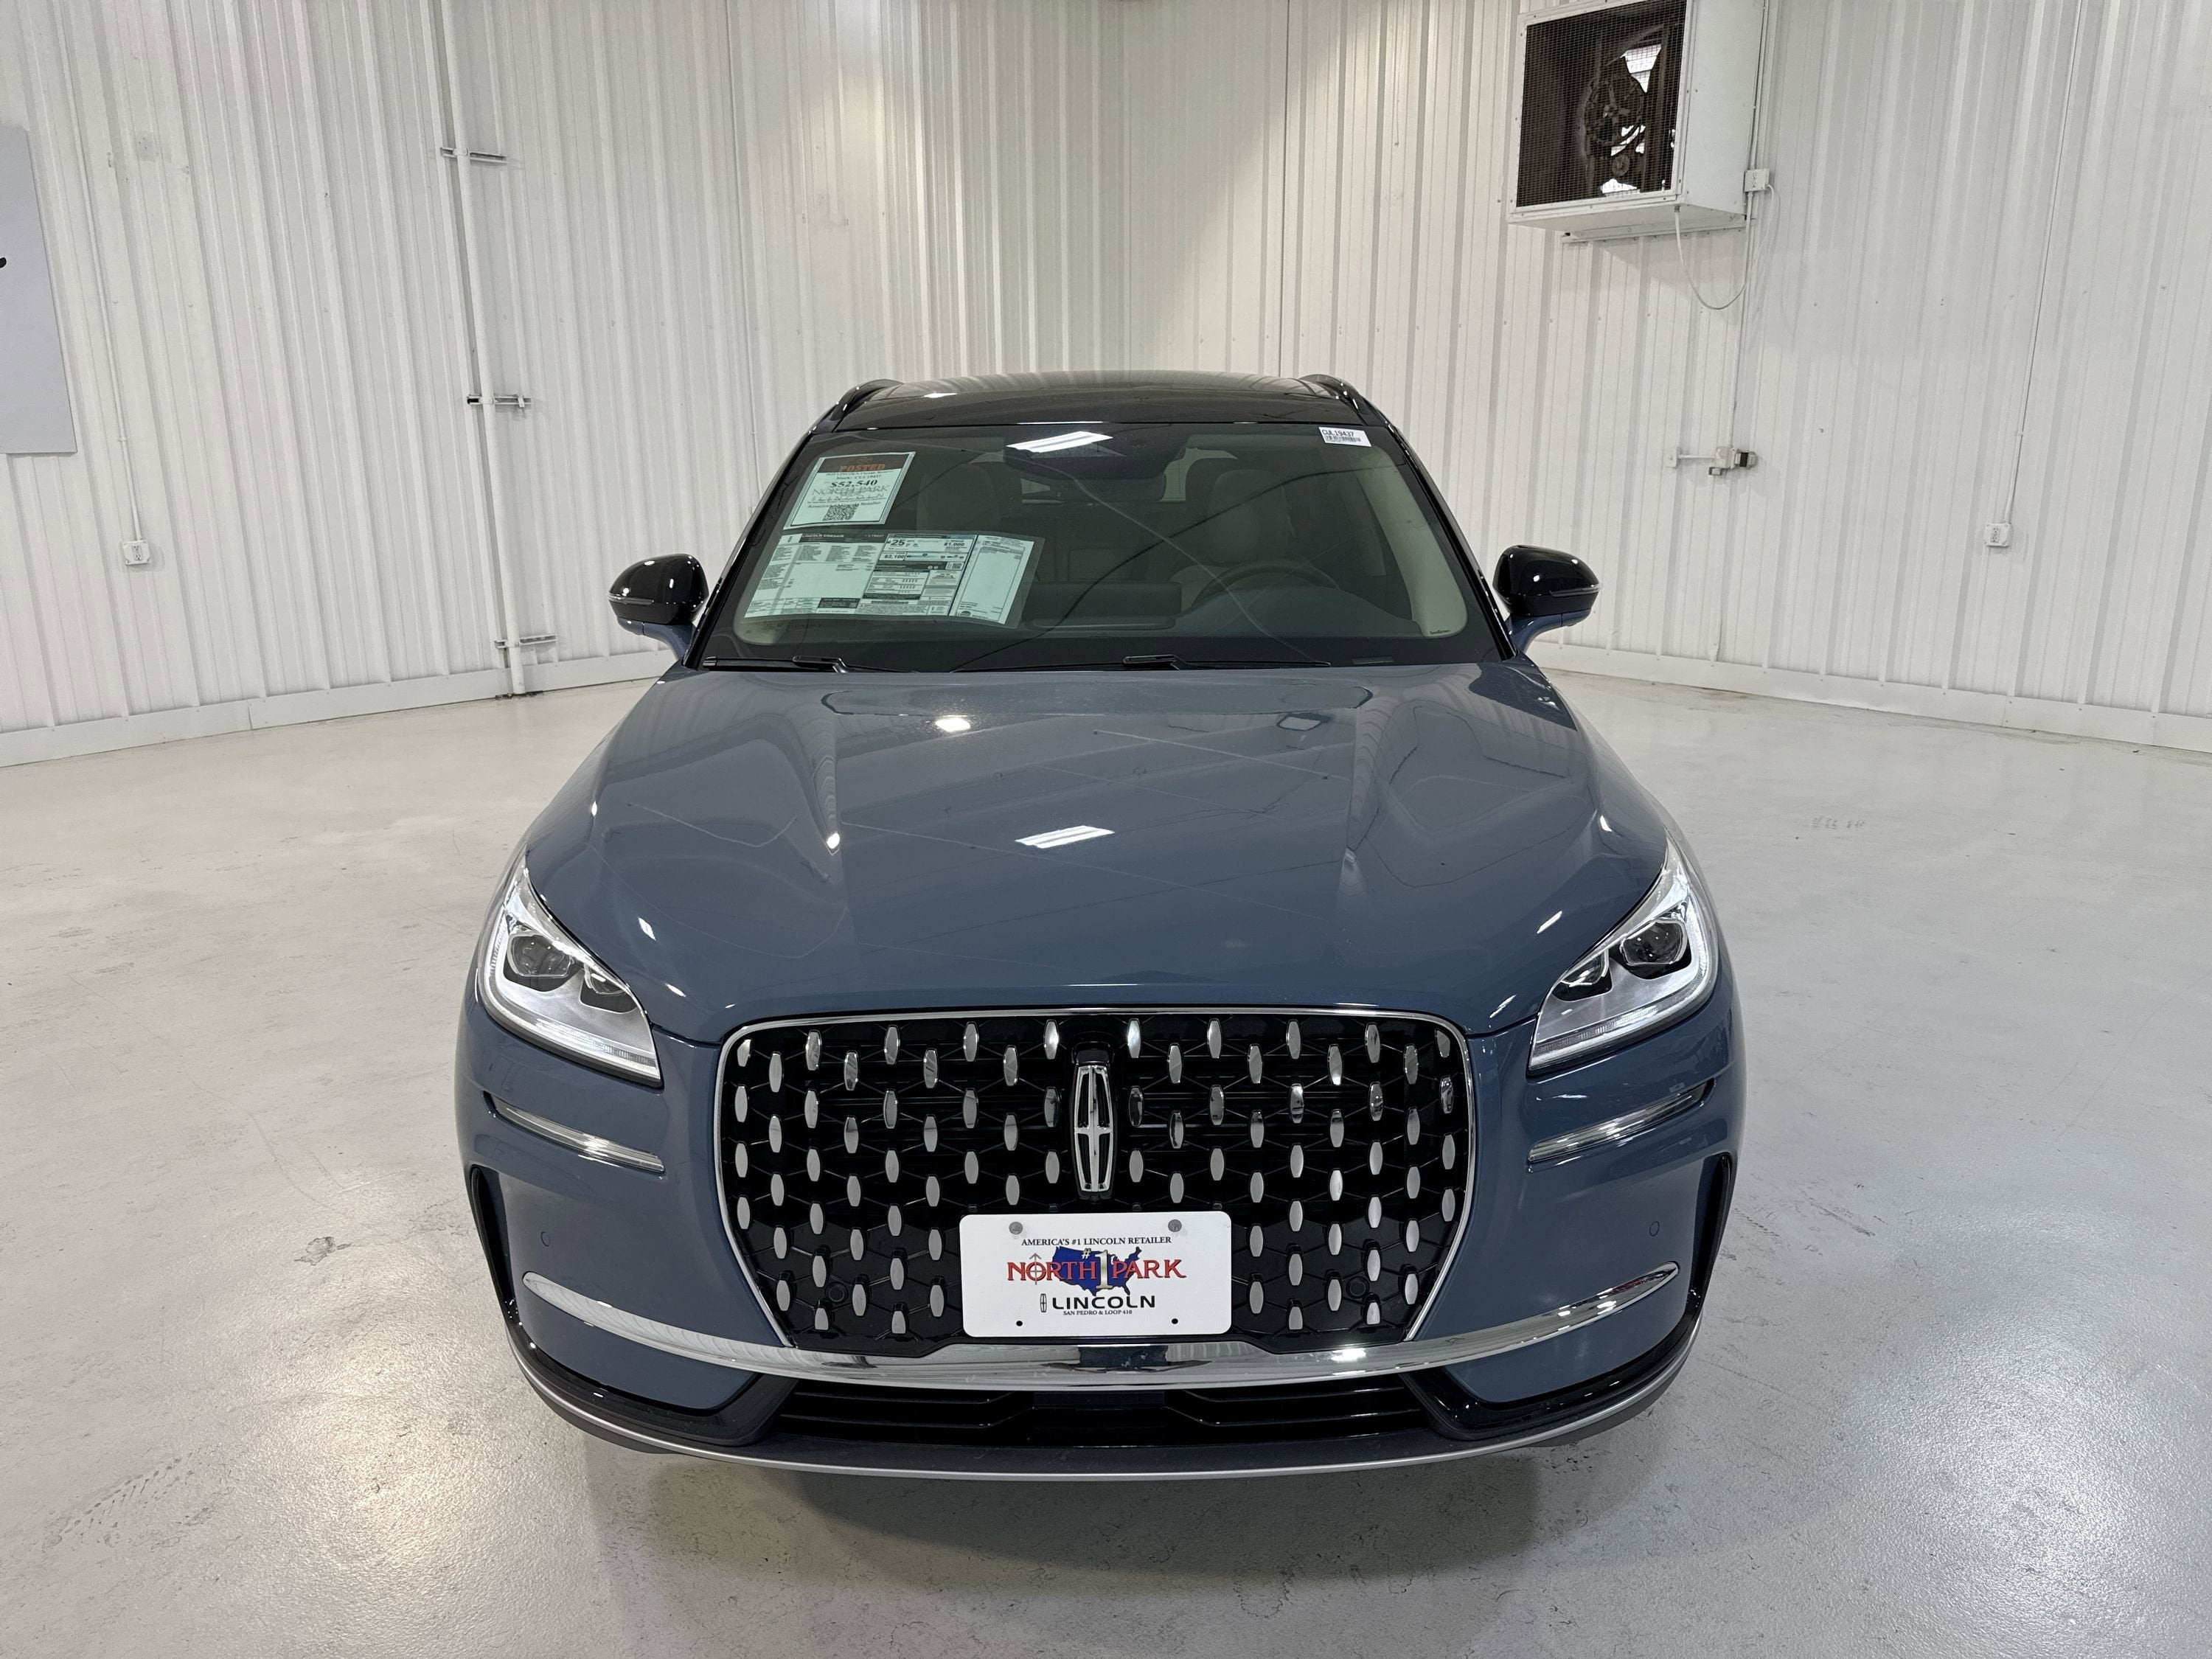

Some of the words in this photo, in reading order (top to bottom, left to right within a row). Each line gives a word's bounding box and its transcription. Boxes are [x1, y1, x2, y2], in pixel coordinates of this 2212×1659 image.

[831, 479, 878, 487] $52,540
[1021, 1238, 1070, 1246] AMERICA'S
[1006, 1259, 1096, 1281] NORTH
[1112, 1259, 1187, 1280] PARK
[1052, 1295, 1155, 1310] LINCOLN
